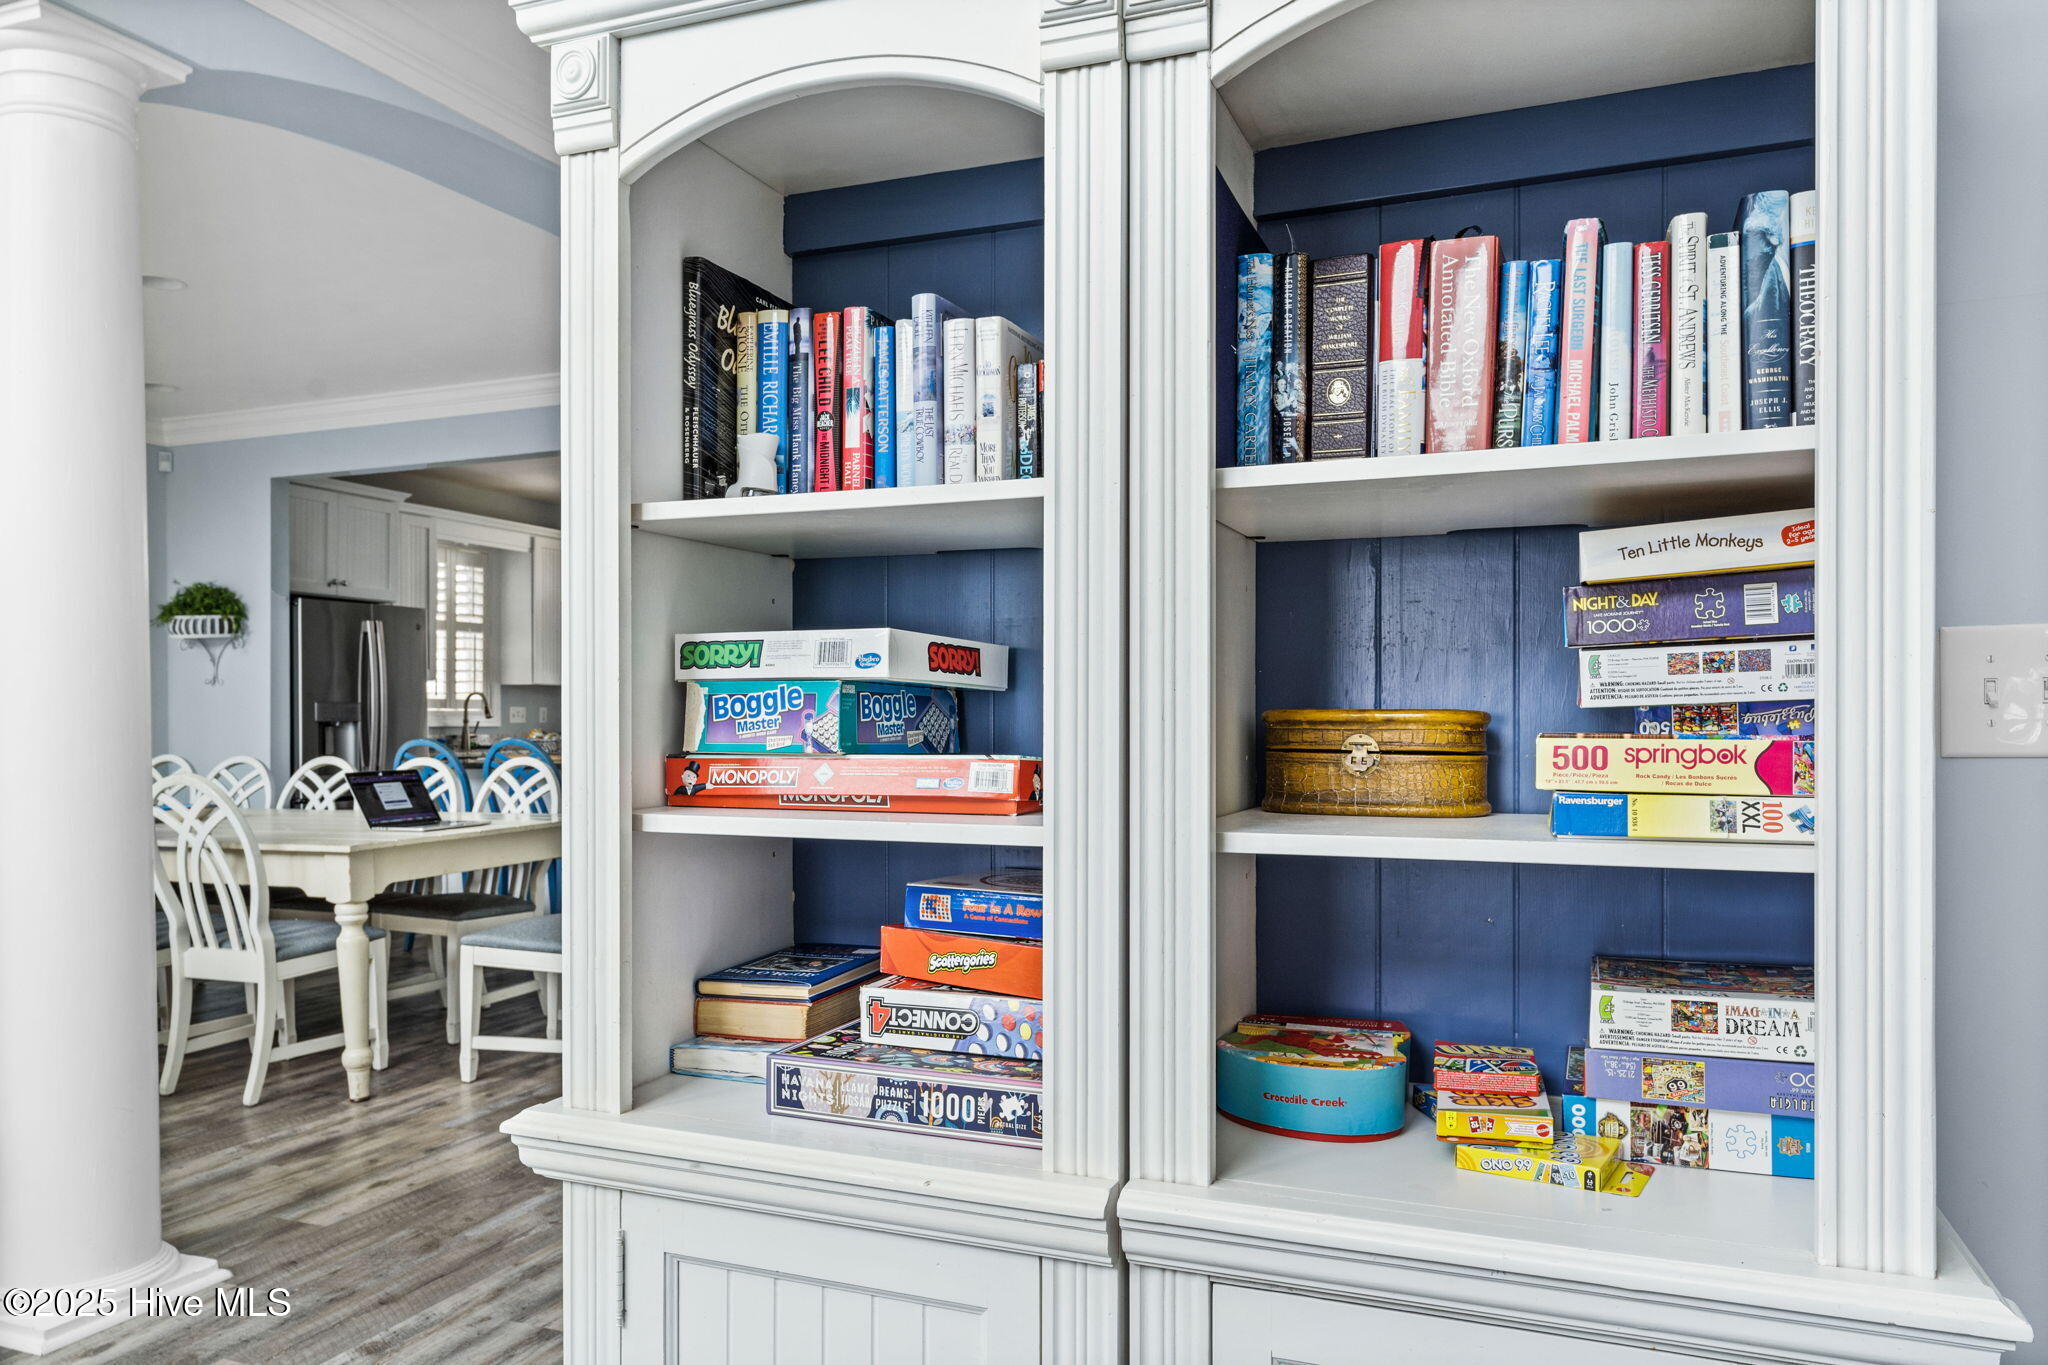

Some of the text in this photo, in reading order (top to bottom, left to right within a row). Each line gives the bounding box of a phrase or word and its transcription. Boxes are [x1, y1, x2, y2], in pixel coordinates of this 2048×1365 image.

[755, 296, 769, 308] CARL
[1570, 242, 1589, 351] THE LAST SURGEON
[1719, 254, 1729, 336] ADVENTURING ALONG THE
[1799, 264, 1815, 367] THEOCRACY
[684, 281, 699, 389] Bluegrass Odyssey
[1284, 311, 1293, 354] CREATION
[1439, 253, 1460, 409] Annotated Bible
[1461, 254, 1483, 408] The New Oxford
[1678, 308, 1698, 370] ANDREWS
[737, 325, 746, 374] STONE
[762, 323, 779, 376] EMILIE
[818, 340, 832, 364] LEE
[792, 363, 802, 384] The
[1243, 356, 1257, 410] JIMMY
[1756, 367, 1782, 375] GEORGE
[740, 384, 749, 408] THE
[791, 385, 802, 404] Big
[818, 367, 832, 406] CHILD
[1608, 382, 1620, 409] John
[925, 407, 934, 421] THE
[1566, 359, 1584, 443] MICHAEL PALM
[1641, 379, 1658, 427] MEPHISTO
[1750, 397, 1779, 406] JOSEPH
[1759, 406, 1781, 414] ELLIS
[792, 406, 803, 431] Miss
[877, 381, 889, 453] PATTERSON
[792, 432, 803, 461] Hank
[915, 408, 925, 464] TRUE COWBOY
[819, 441, 830, 485] MIDNIGHT
[981, 453, 996, 464] THAN
[983, 464, 995, 475] YOU
[844, 461, 852, 487] HALL
[1791, 523, 1810, 532] Ideal
[1617, 533, 1764, 561] Ten Little Monkeys
[1786, 537, 1799, 545] 2-5
[1587, 618, 1637, 634] 1000
[681, 641, 762, 669] SORRY!
[928, 643, 981, 676] SORRY!
[712, 684, 804, 722] Boggle
[860, 688, 917, 722] Boggle
[737, 717, 780, 733] Master
[877, 722, 905, 737] Master
[1552, 745, 1609, 771] 500
[1624, 744, 1748, 770] springbok
[712, 769, 796, 785] MONOPOLY
[1558, 796, 1624, 806] Ravensburger
[1741, 801, 1761, 833] XXL
[1761, 801, 1784, 833] 100
[1003, 903, 1013, 915] A
[1016, 904, 1042, 918] Row
[929, 950, 997, 973] Scattergories
[870, 1001, 977, 1033] CONNECT 4
[1725, 1018, 1801, 1038] DREAM
[781, 1088, 835, 1106] NIGHTS
[875, 1099, 909, 1113] PUZZLE
[922, 1089, 976, 1122] 1000
[1263, 1092, 1346, 1108] Crocodile Creek
[1480, 1158, 1533, 1172] ONO 99
